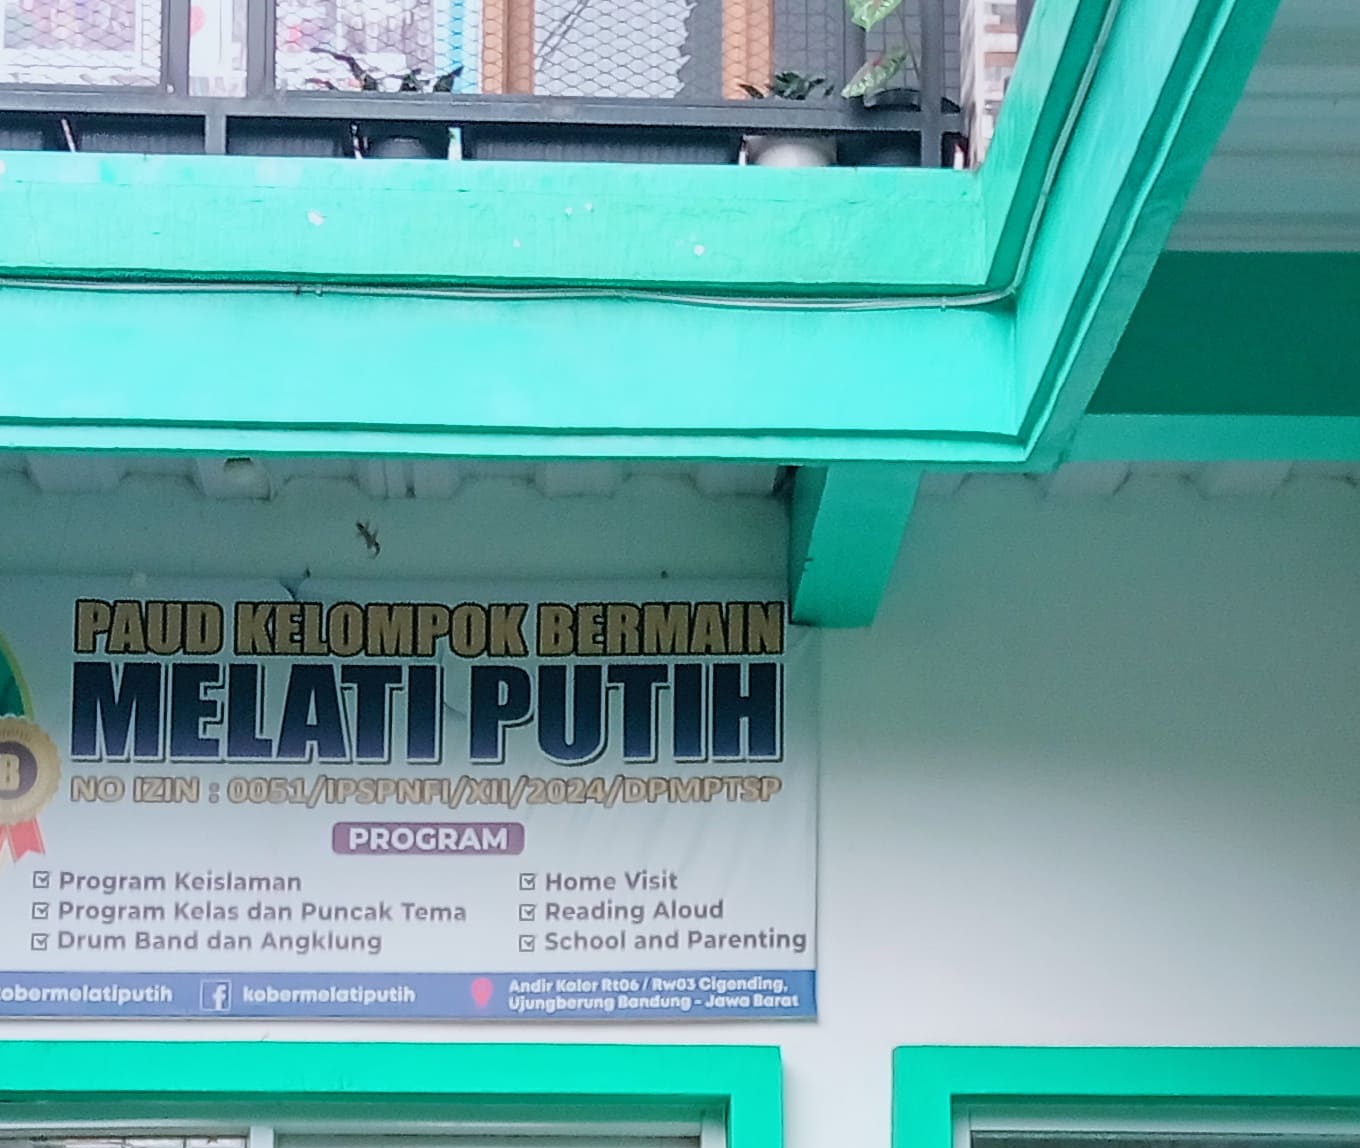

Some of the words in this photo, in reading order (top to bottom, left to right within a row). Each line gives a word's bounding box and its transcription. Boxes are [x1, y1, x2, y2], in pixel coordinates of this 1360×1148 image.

[74, 598, 224, 655] PAUD
[234, 600, 529, 658] KELOMPOK
[537, 601, 785, 657] BERMAIN
[70, 661, 443, 765] MELATI
[469, 662, 784, 766] PUTIH
[71, 775, 125, 804] NO
[133, 776, 200, 804] IZIN
[348, 826, 508, 852] PROGRAM
[58, 870, 166, 897] Program
[174, 869, 302, 892] Keislaman
[545, 872, 616, 892] Home
[624, 870, 679, 891] Visit
[58, 901, 165, 926] Program
[174, 901, 240, 922] Kelas
[247, 901, 293, 922] dan
[301, 901, 392, 922] Puncak
[401, 902, 467, 922] Tema
[545, 901, 645, 924] Reading
[653, 899, 724, 920] Aloud
[57, 931, 126, 951] Drum
[135, 930, 198, 951] Band
[207, 930, 252, 951] dan
[261, 931, 383, 956] Angklung
[544, 932, 626, 952] School
[634, 931, 679, 951] and
[687, 927, 808, 953] Parenting
[242, 984, 416, 1006] kobermelatiputih
[509, 978, 553, 993] Andir
[601, 977, 639, 992] Rt06
[652, 977, 696, 992] Rw03
[698, 975, 789, 993] Cigending,
[508, 995, 613, 1014] Ujungberung
[618, 994, 691, 1012] Bandung
[705, 994, 750, 1009] Jawa
[752, 993, 800, 1008] Barat
